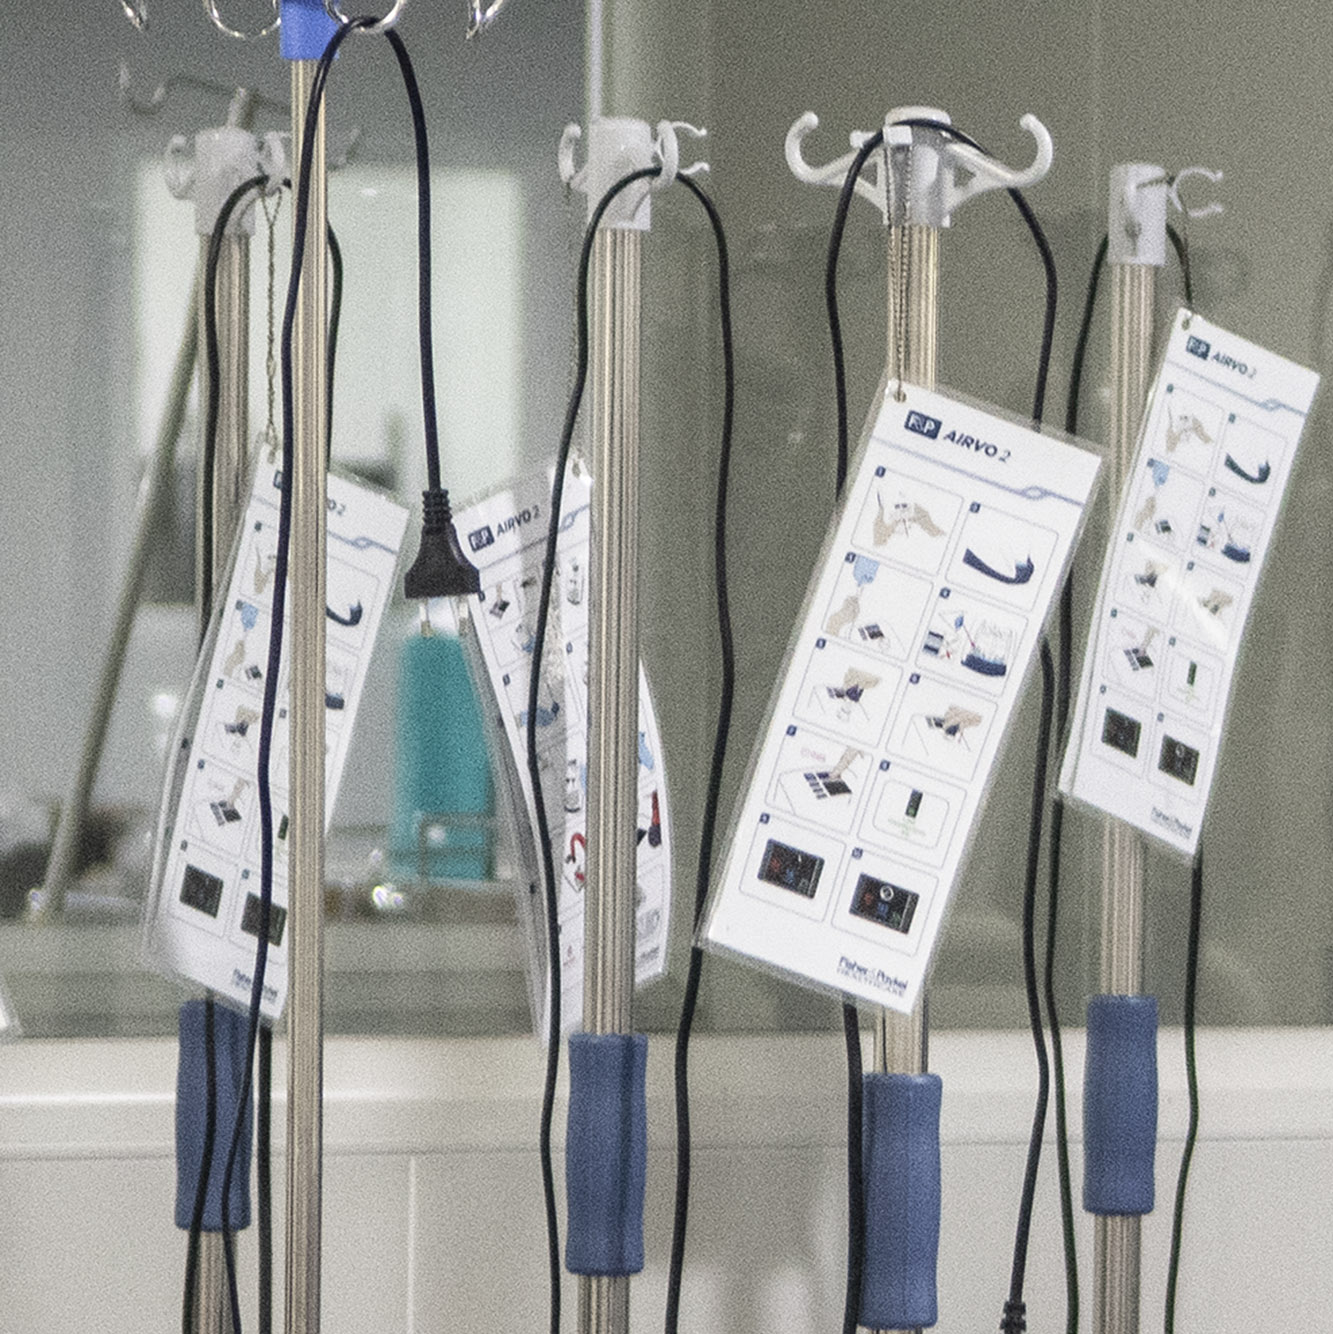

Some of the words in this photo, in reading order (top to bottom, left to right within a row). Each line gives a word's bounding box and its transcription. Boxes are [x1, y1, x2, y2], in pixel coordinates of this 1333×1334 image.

[1211, 351, 1249, 376] AIRVO
[943, 430, 998, 458] AIRVO
[998, 450, 1012, 463] 2
[497, 508, 531, 537] AIRVO
[532, 504, 540, 520] 2
